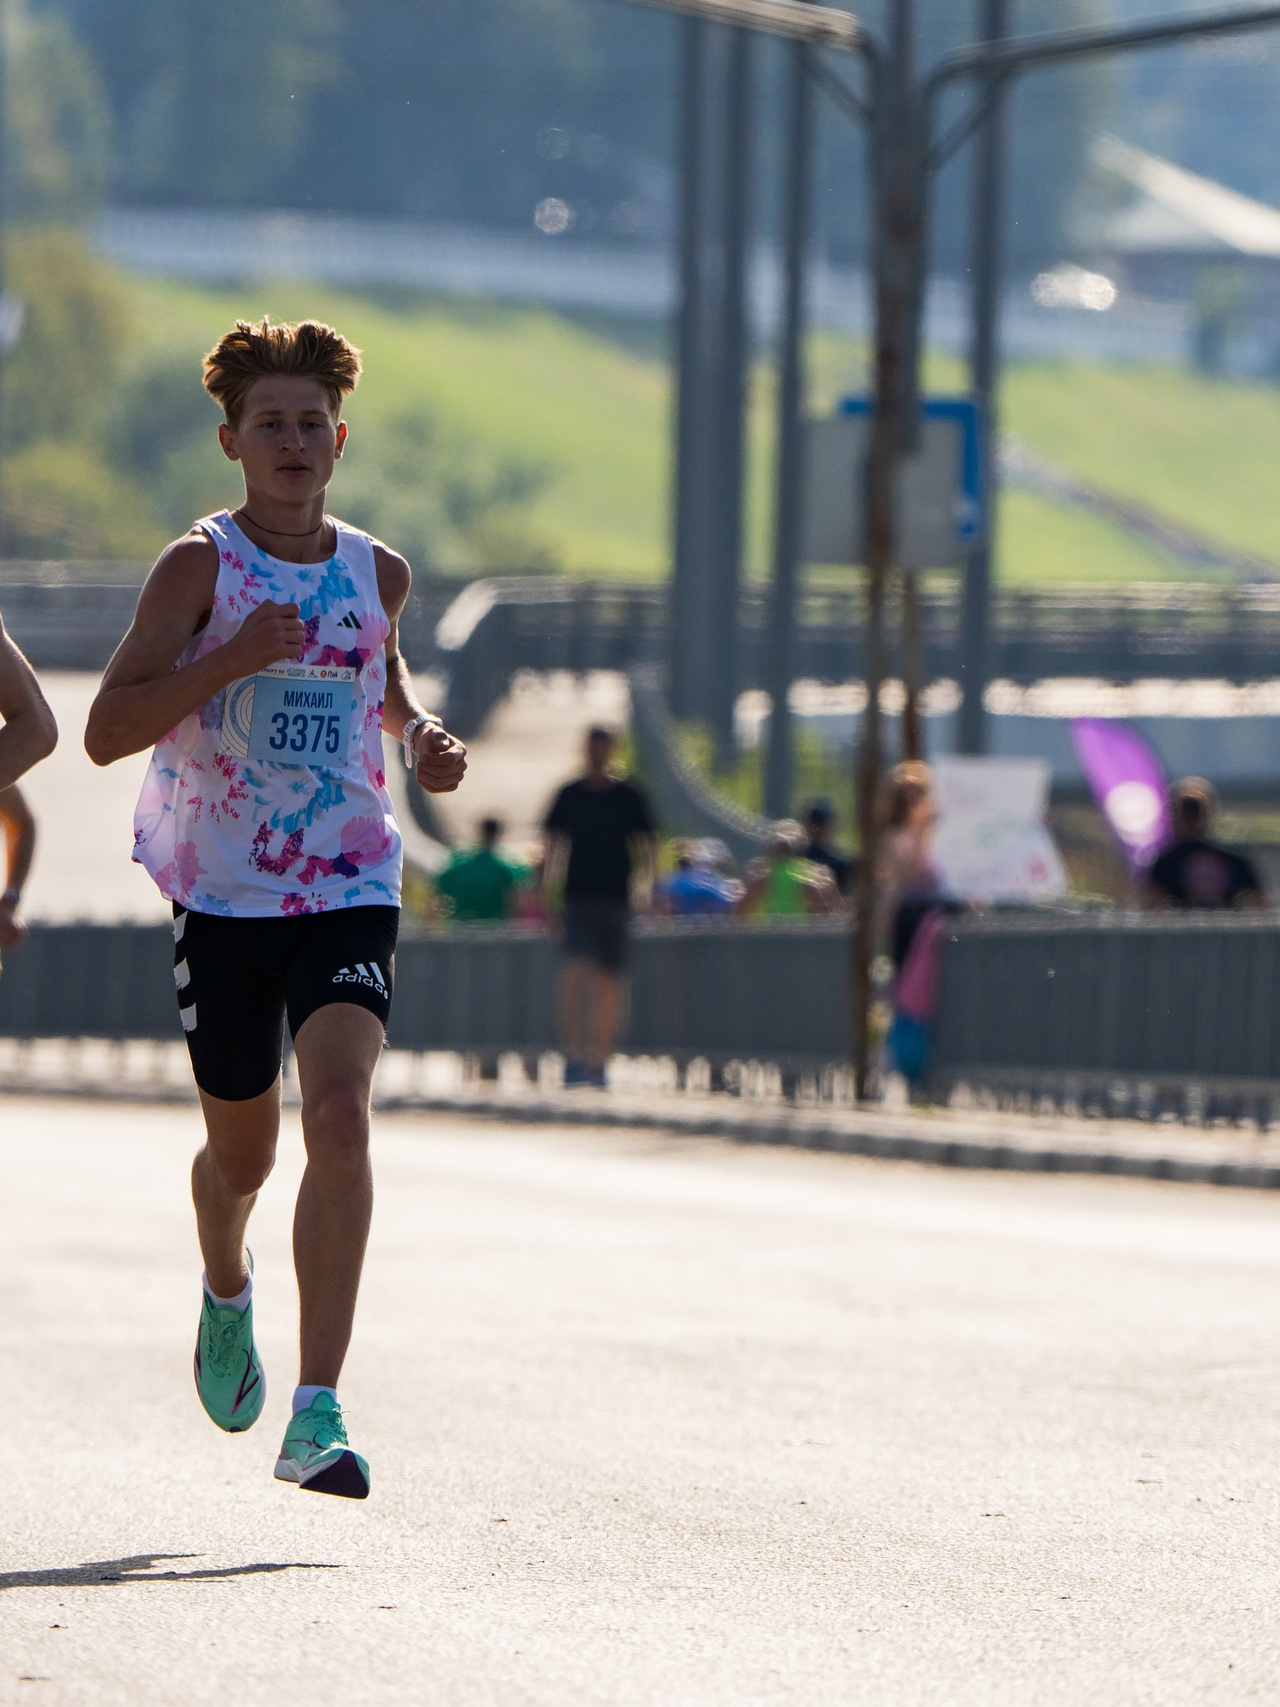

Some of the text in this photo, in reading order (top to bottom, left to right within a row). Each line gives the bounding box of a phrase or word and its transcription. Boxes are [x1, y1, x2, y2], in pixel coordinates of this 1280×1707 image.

[283, 690, 333, 709] МИХАИЛ
[269, 712, 341, 753] 3375
[332, 973, 388, 1000] adidas
